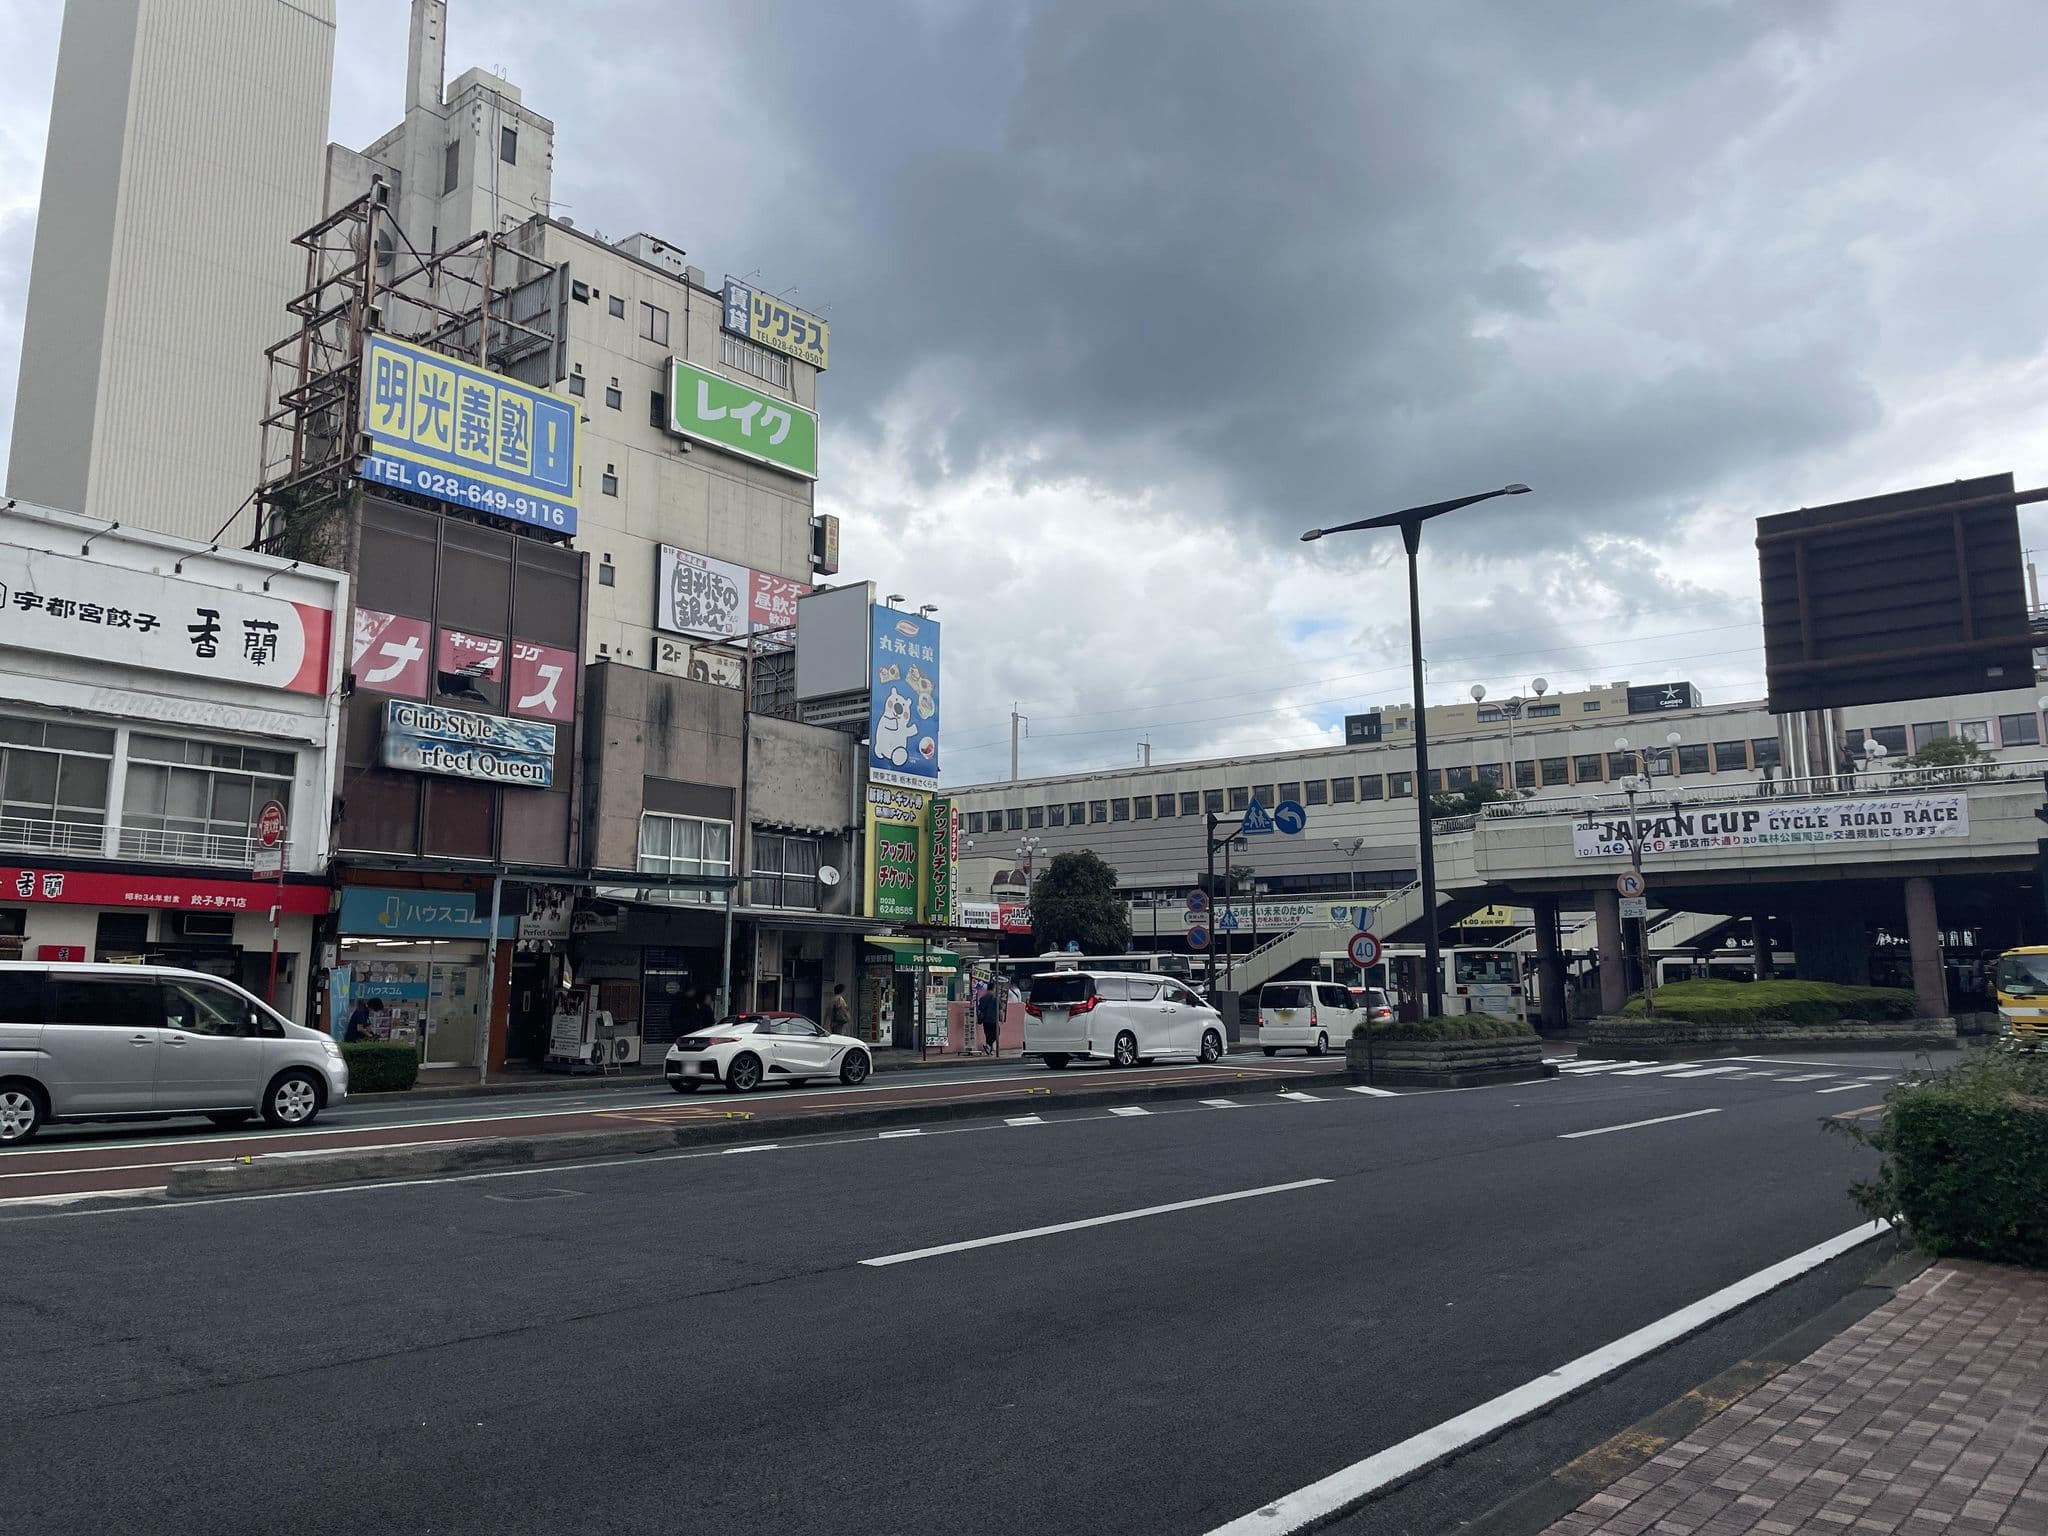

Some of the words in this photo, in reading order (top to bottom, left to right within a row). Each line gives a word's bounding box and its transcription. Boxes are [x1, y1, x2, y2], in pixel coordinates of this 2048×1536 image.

[729, 286, 748, 333] 賃貸
[754, 298, 824, 354] リクラス
[697, 379, 792, 445] レイク
[371, 456, 412, 485] TEL
[417, 470, 565, 526] 028-649-9116
[758, 574, 803, 599] ランチ
[13, 590, 161, 633] 宇都宮餃子
[187, 607, 280, 667] 香蘭
[662, 643, 681, 663] 2F
[878, 634, 935, 663] 丸永製菓
[397, 707, 442, 732] Club
[446, 716, 493, 739] Style
[477, 754, 545, 781] Queen
[1598, 815, 1695, 842] JAPAN
[1701, 811, 1760, 835] CUP
[1769, 814, 1829, 831] CYCLE
[1840, 811, 1893, 827] ROAD
[1904, 807, 1959, 824] RACE
[880, 840, 916, 864] アップル
[932, 805, 947, 912] アップルチケット
[16, 871, 65, 898] 香蘭
[879, 865, 915, 890] チケット
[190, 894, 248, 908] 餃子専門店
[1355, 942, 1374, 959] 40
[366, 985, 403, 996] ハウスコム
